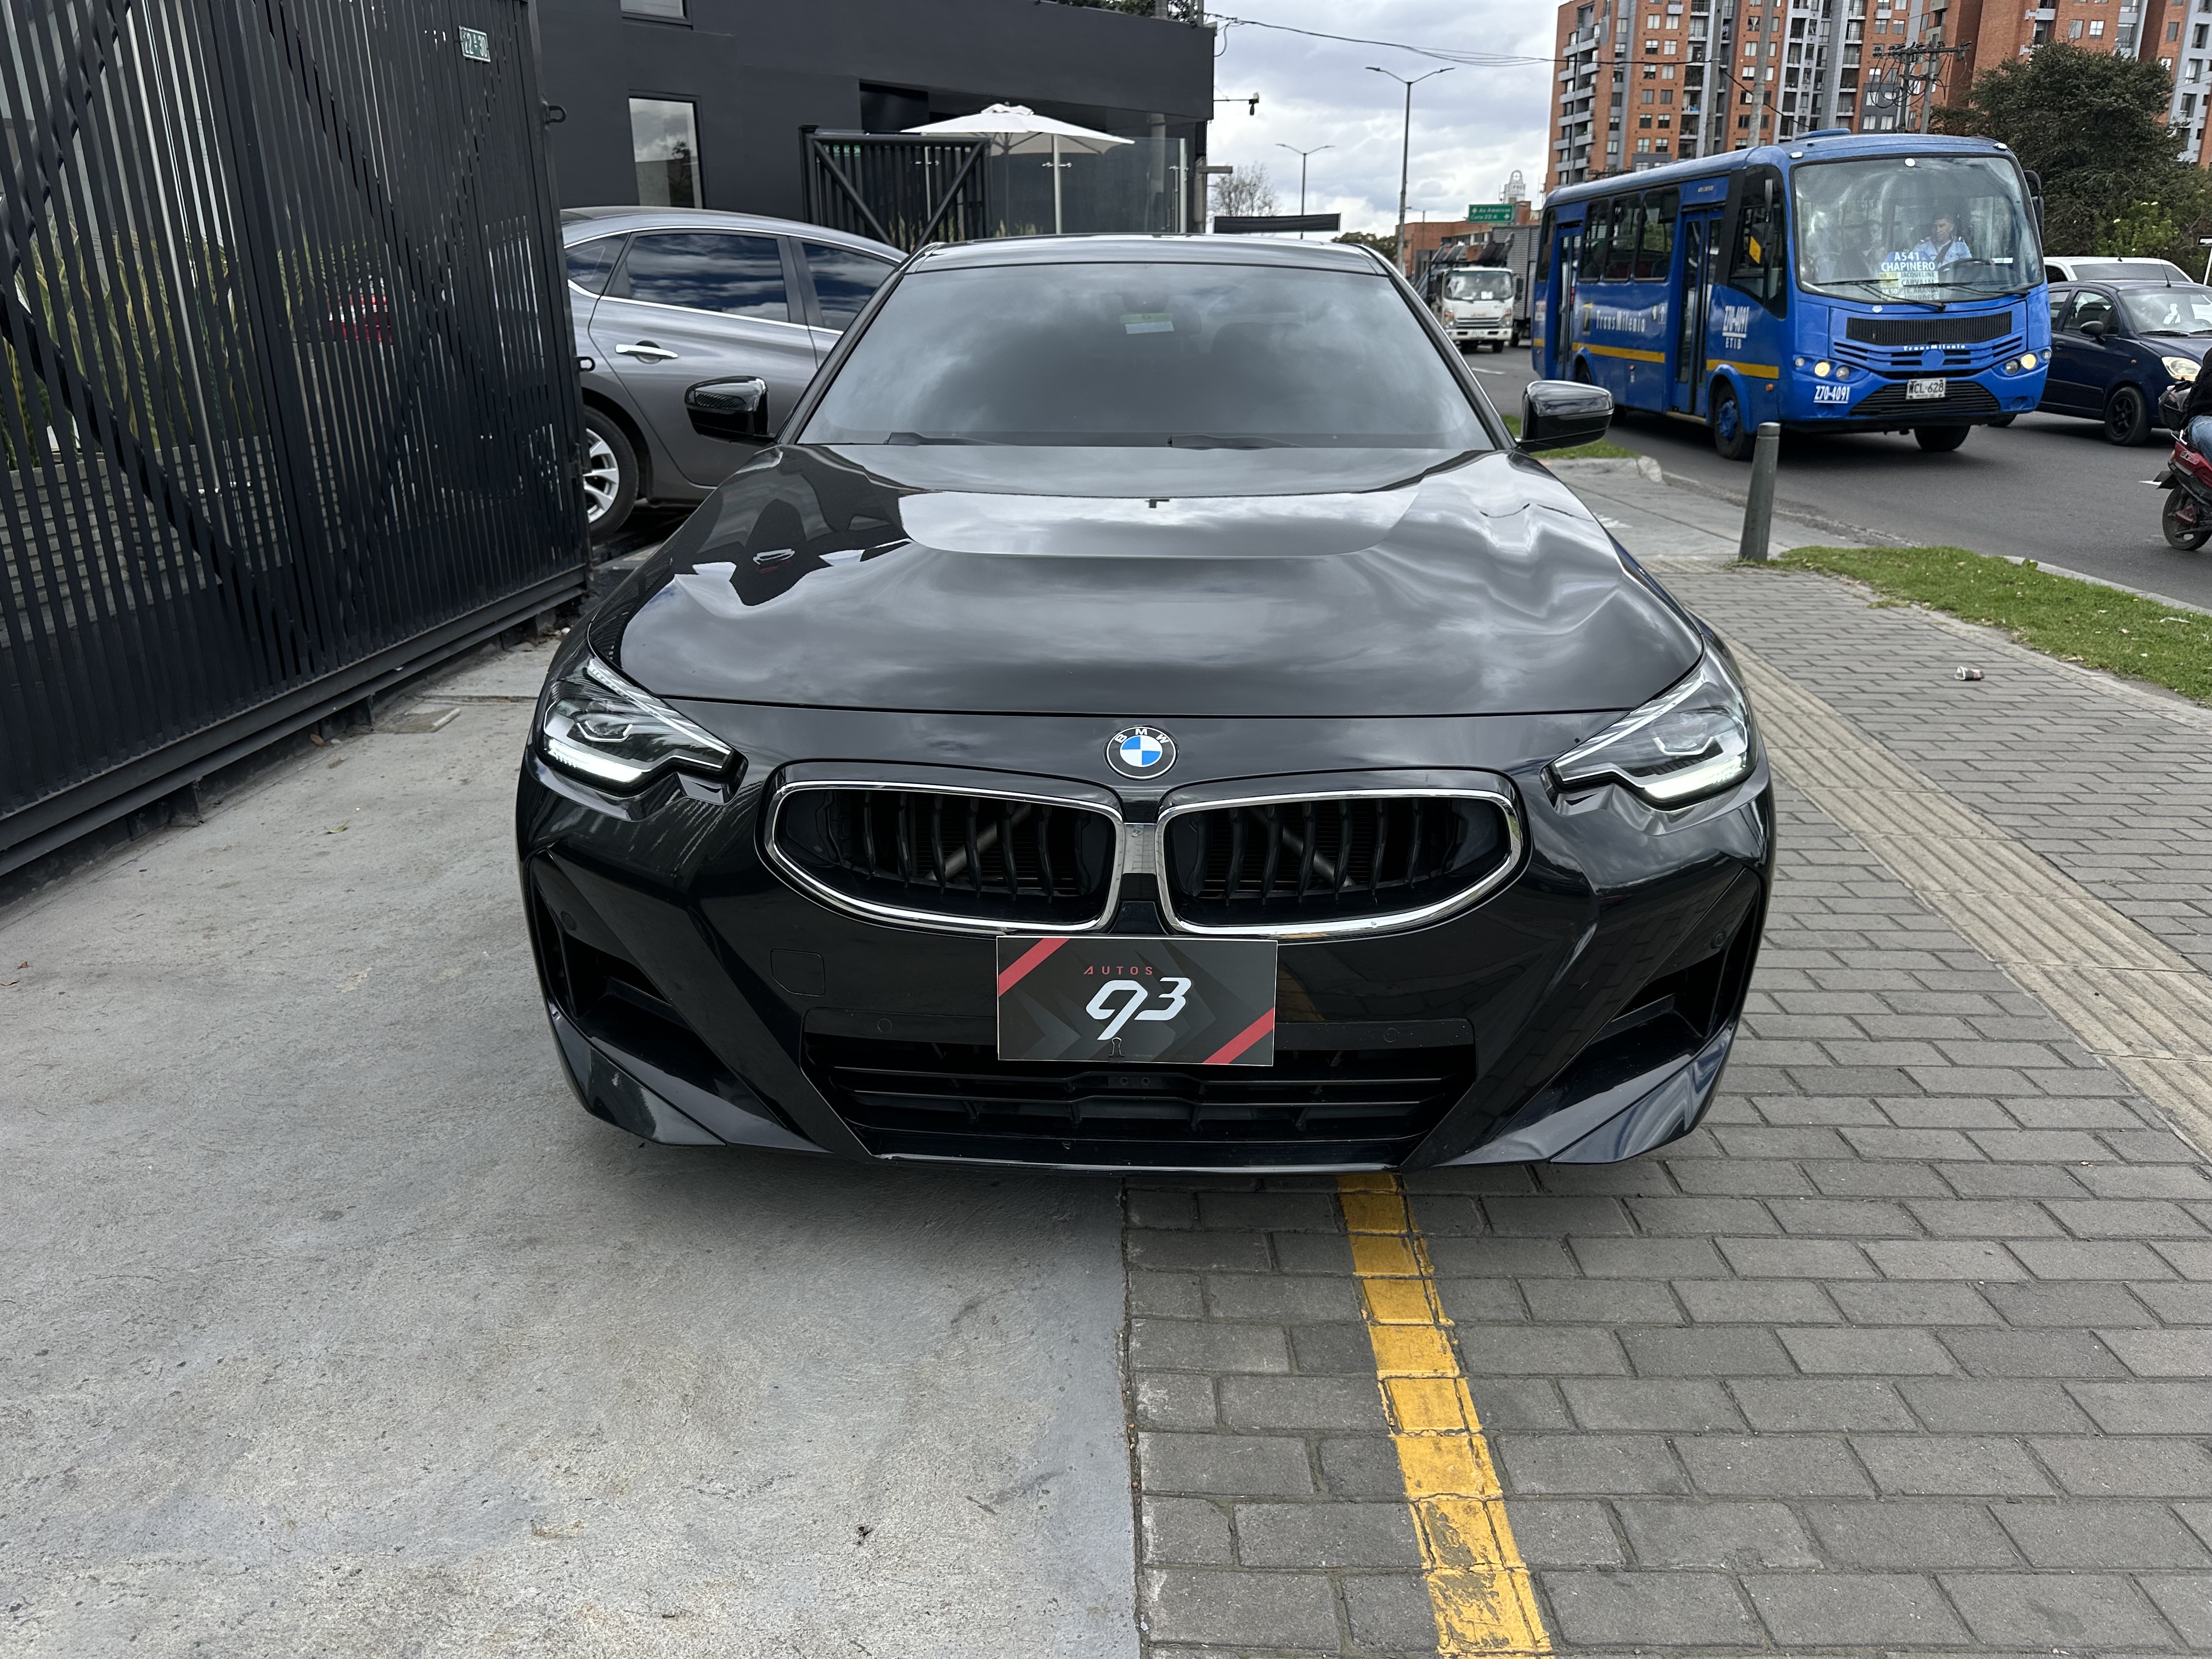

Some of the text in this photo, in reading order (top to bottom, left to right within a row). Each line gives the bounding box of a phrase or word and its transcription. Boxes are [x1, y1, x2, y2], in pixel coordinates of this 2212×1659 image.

[1894, 251, 1920, 261] A541
[1880, 262, 1936, 272] CHAPINERO
[1596, 309, 1645, 332] TransMilenio
[1814, 385, 1851, 401] Z70-4091
[1114, 728, 1170, 743] BMW
[1083, 966, 1153, 975] AUTOS
[1086, 977, 1192, 1040] 93
